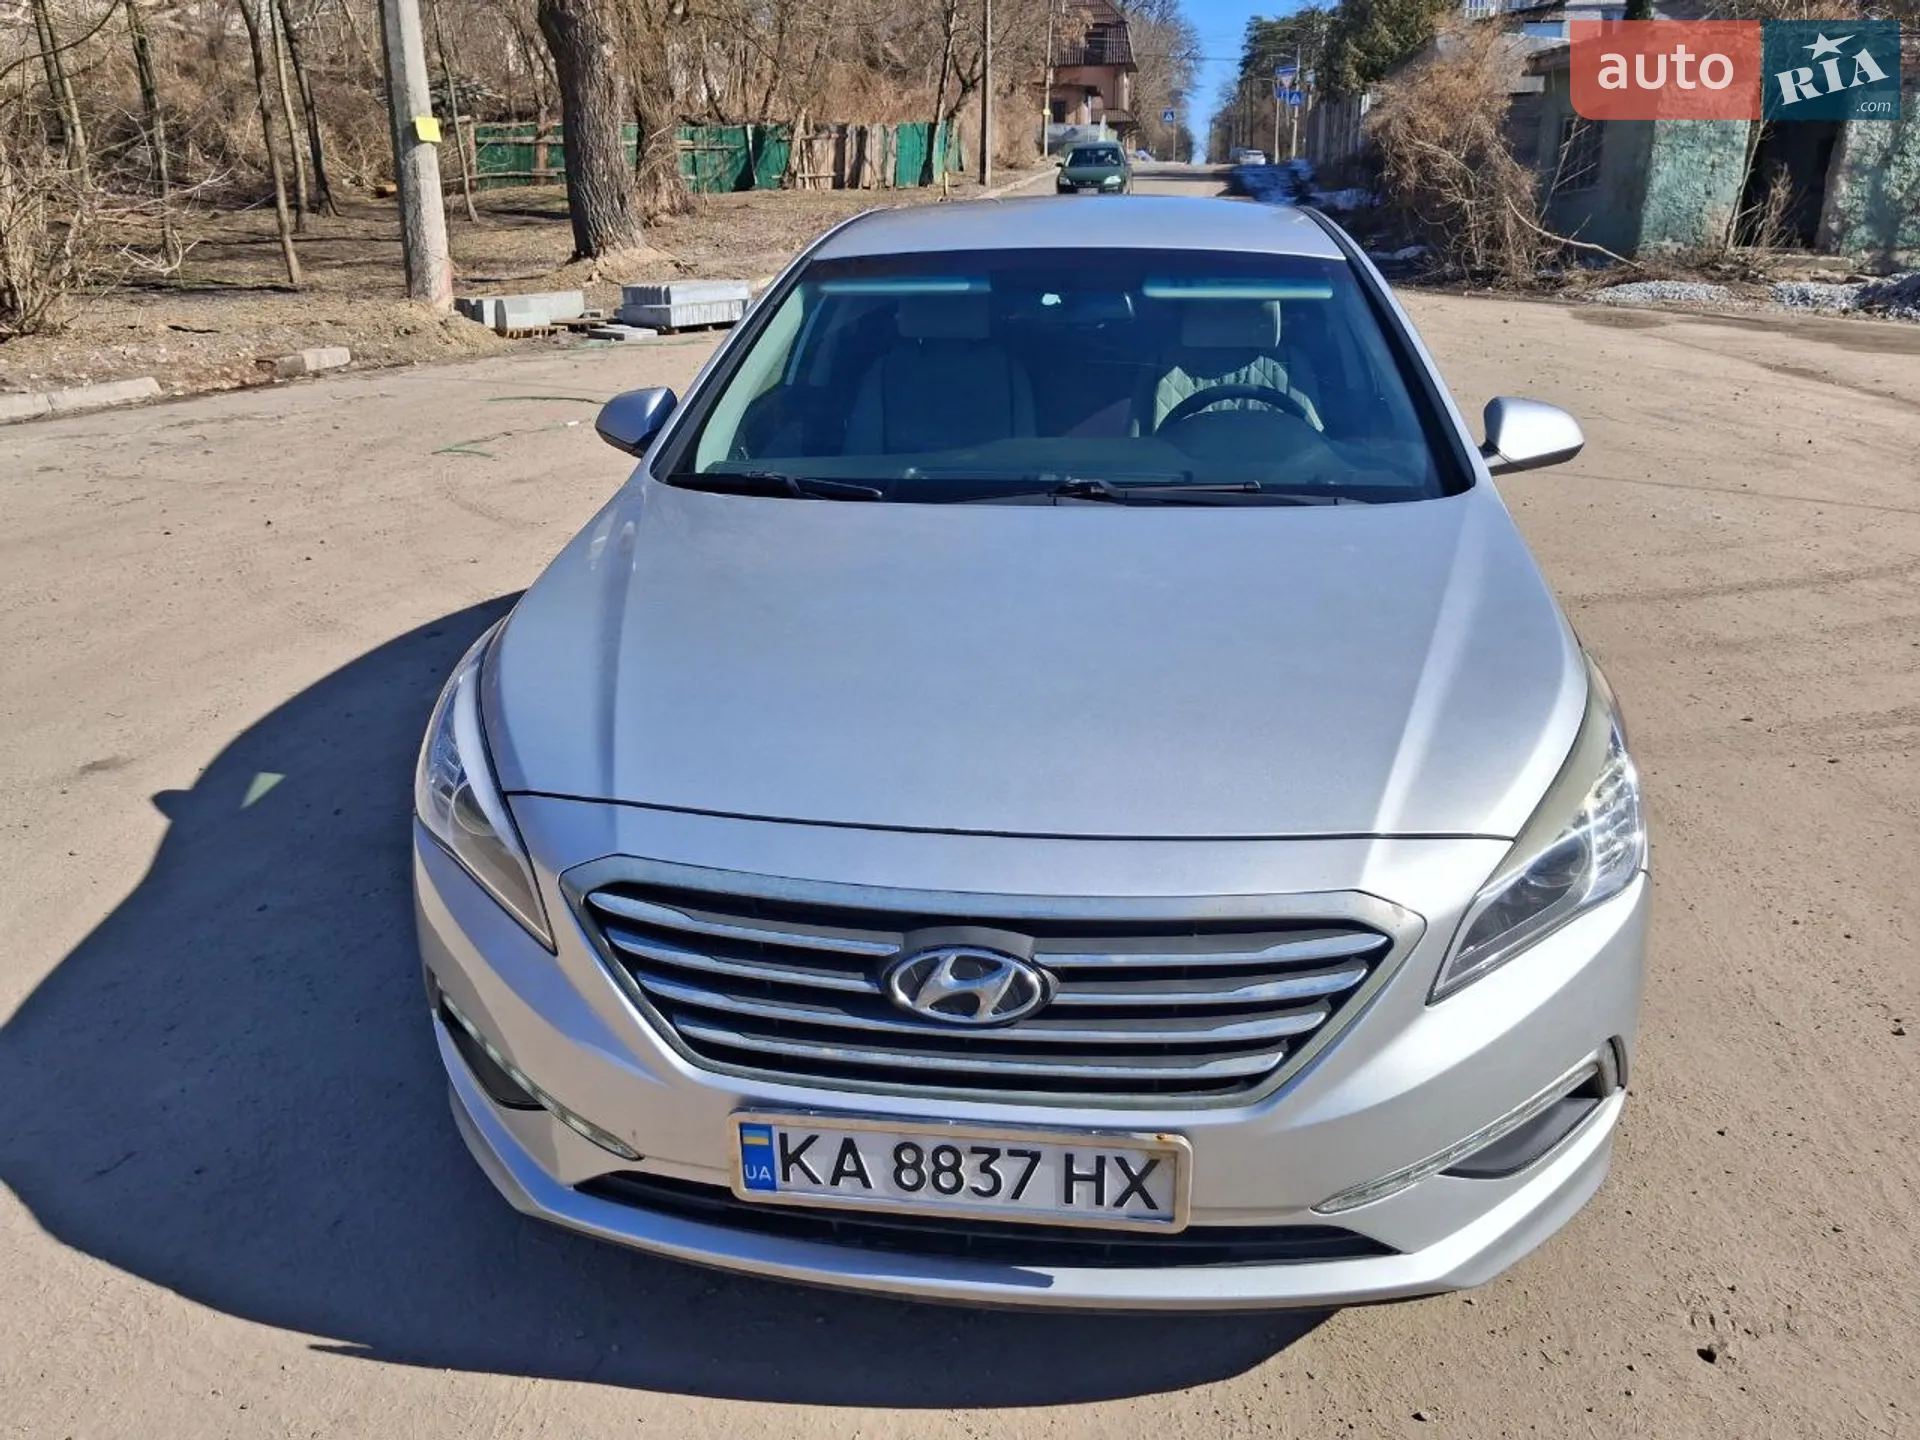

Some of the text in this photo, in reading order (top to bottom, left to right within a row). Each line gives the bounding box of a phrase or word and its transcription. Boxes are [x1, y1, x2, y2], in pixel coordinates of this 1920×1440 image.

[745, 1164, 772, 1181] UA
[778, 1132, 1161, 1210] KA 8837 HX
